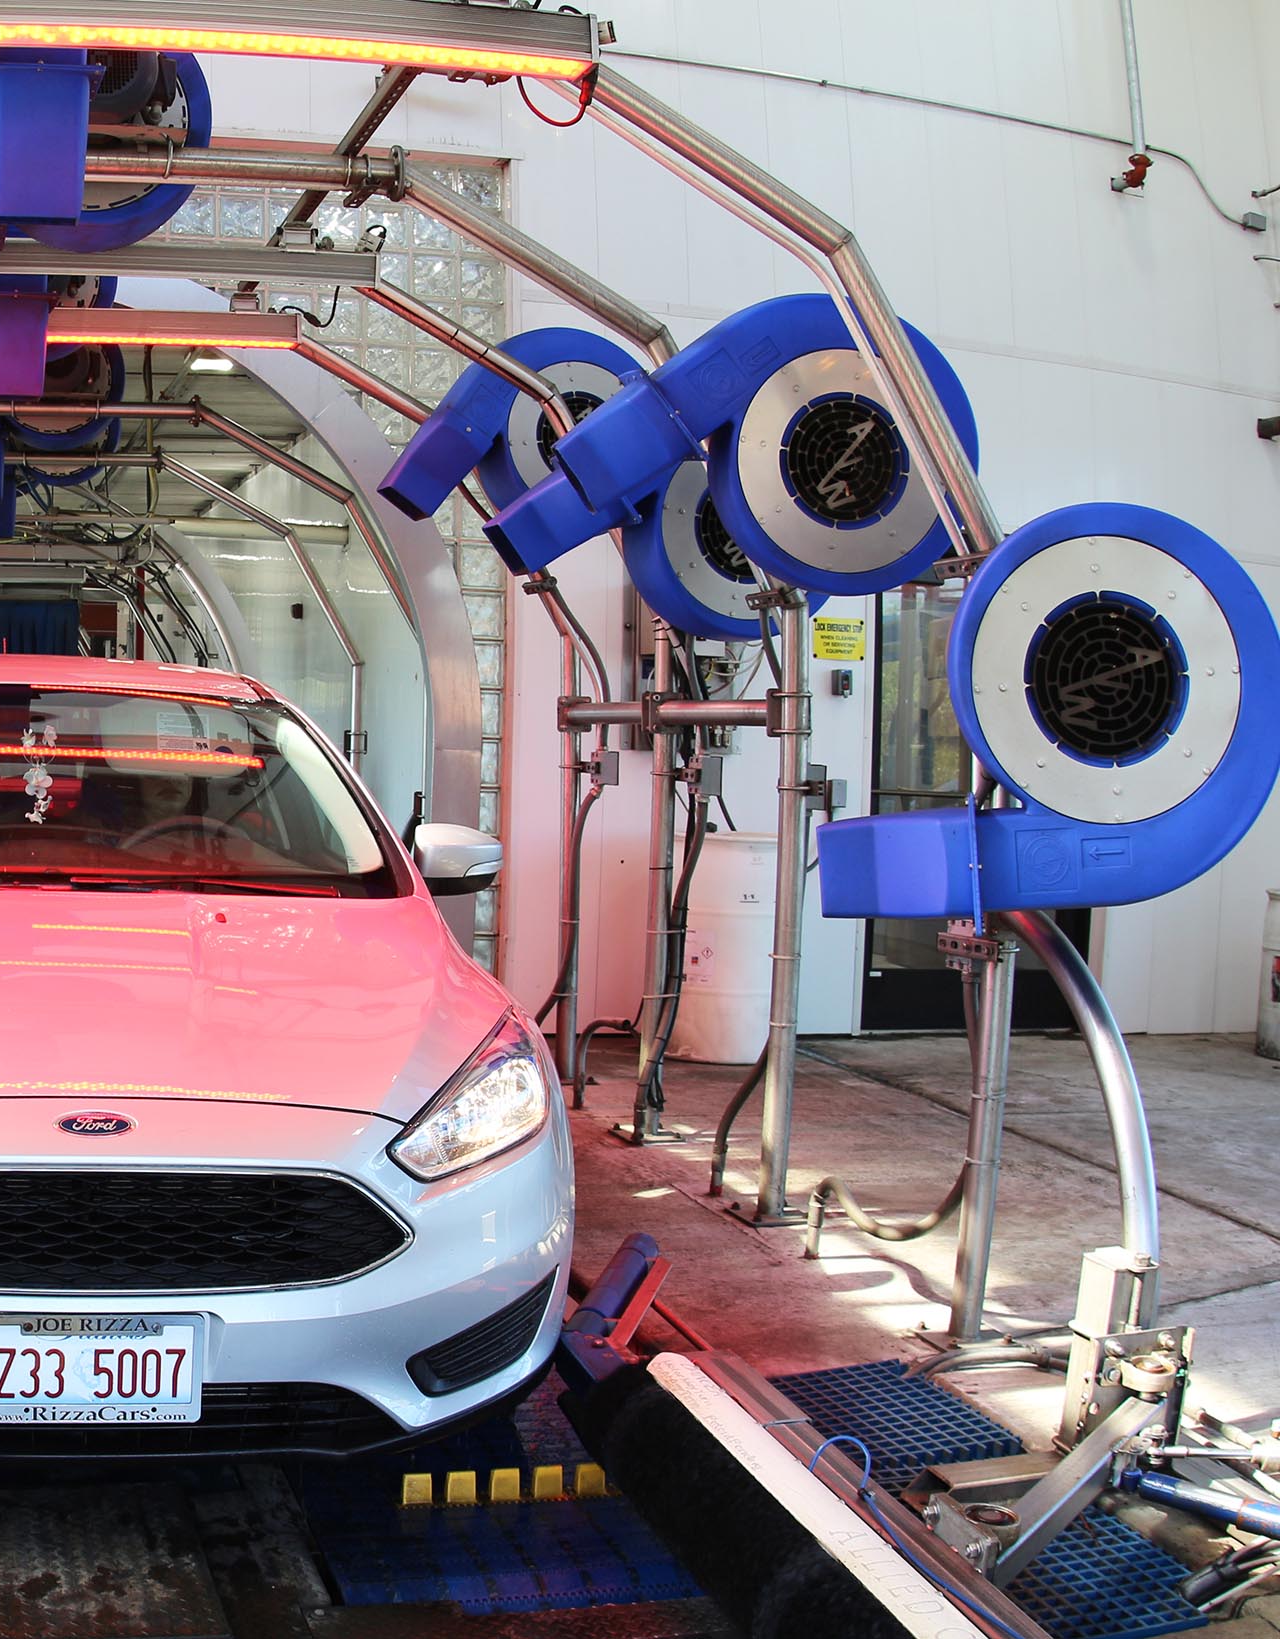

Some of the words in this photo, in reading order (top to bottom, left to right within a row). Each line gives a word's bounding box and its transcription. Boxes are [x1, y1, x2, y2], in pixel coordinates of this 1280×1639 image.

[815, 623, 825, 631] LOCK
[827, 624, 852, 632] EMERGENCY
[72, 1116, 117, 1131] Ford
[34, 1318, 72, 1333] JOE
[80, 1318, 148, 1332] RIZZA
[93, 1348, 187, 1399] 5007
[828, 1529, 945, 1615] ALLIED
